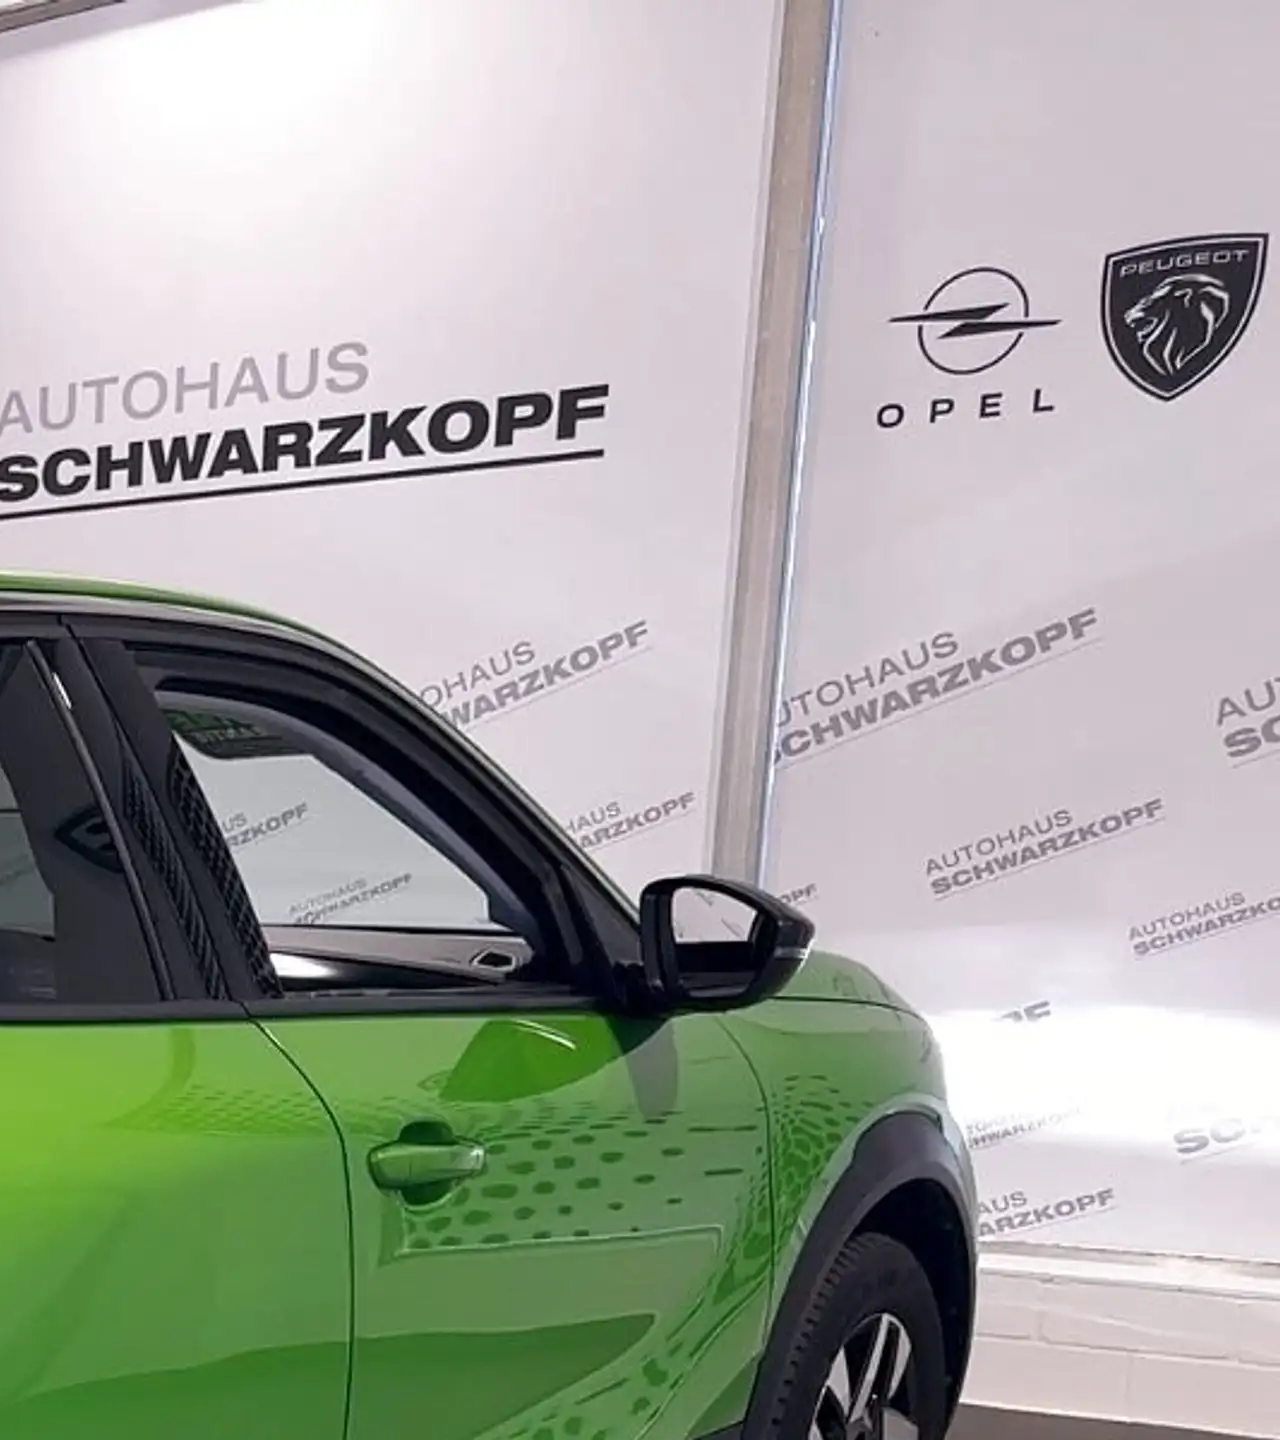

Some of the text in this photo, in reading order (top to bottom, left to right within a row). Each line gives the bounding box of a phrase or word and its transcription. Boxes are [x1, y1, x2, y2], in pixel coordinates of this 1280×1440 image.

[1119, 249, 1250, 279] PEUGEOT
[876, 388, 1056, 429] OPEL
[420, 641, 535, 709] OHAUS
[441, 619, 649, 727] WARZKOPF
[774, 608, 1098, 765] CHWARZKOPF
[579, 791, 696, 848] ARZKOPF
[925, 809, 1073, 876] AUTOHAUS
[932, 798, 1164, 896] SCHWARZKOPF
[1128, 891, 1246, 941] AUTOHAUS
[1132, 896, 1280, 957] SCHWARZKO
[978, 1188, 1115, 1238] ARZKOPF
